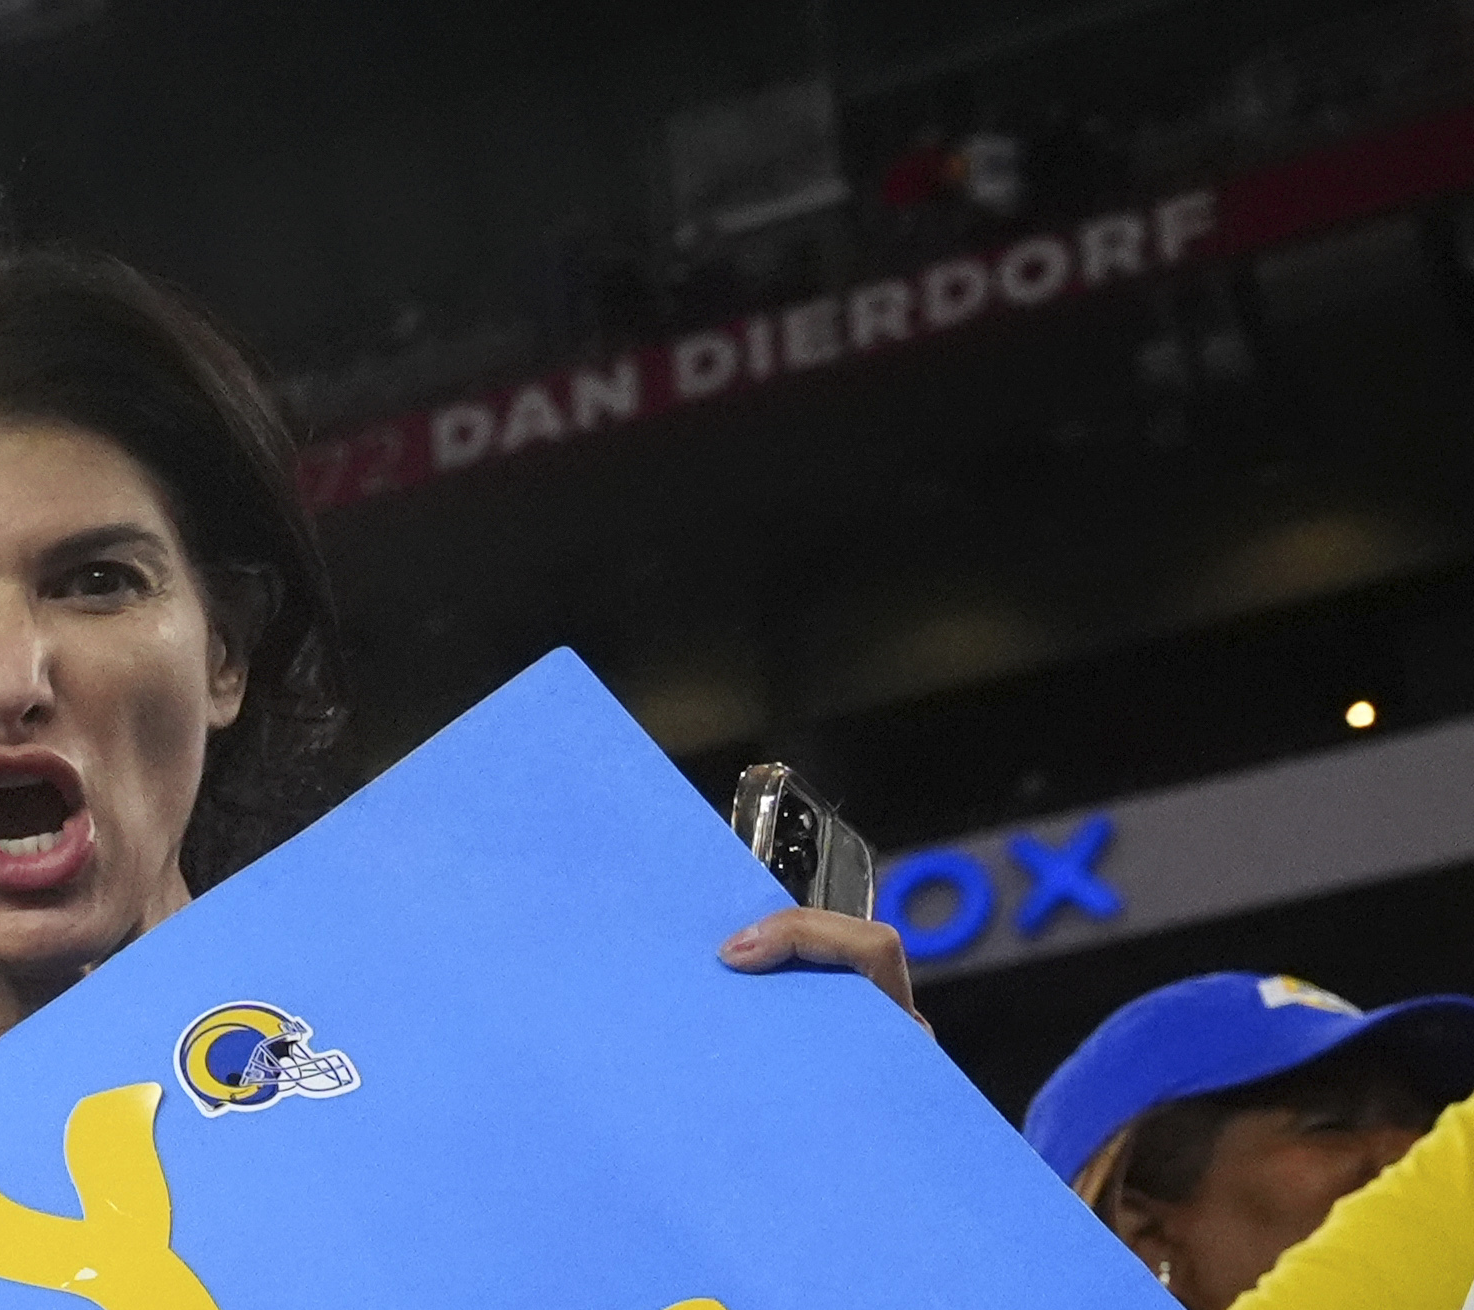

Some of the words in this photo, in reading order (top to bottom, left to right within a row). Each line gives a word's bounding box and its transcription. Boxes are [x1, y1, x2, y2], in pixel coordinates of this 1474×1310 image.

[430, 361, 642, 471] DAN
[673, 195, 1218, 402] DIERDORF
[878, 812, 1122, 963] OX
